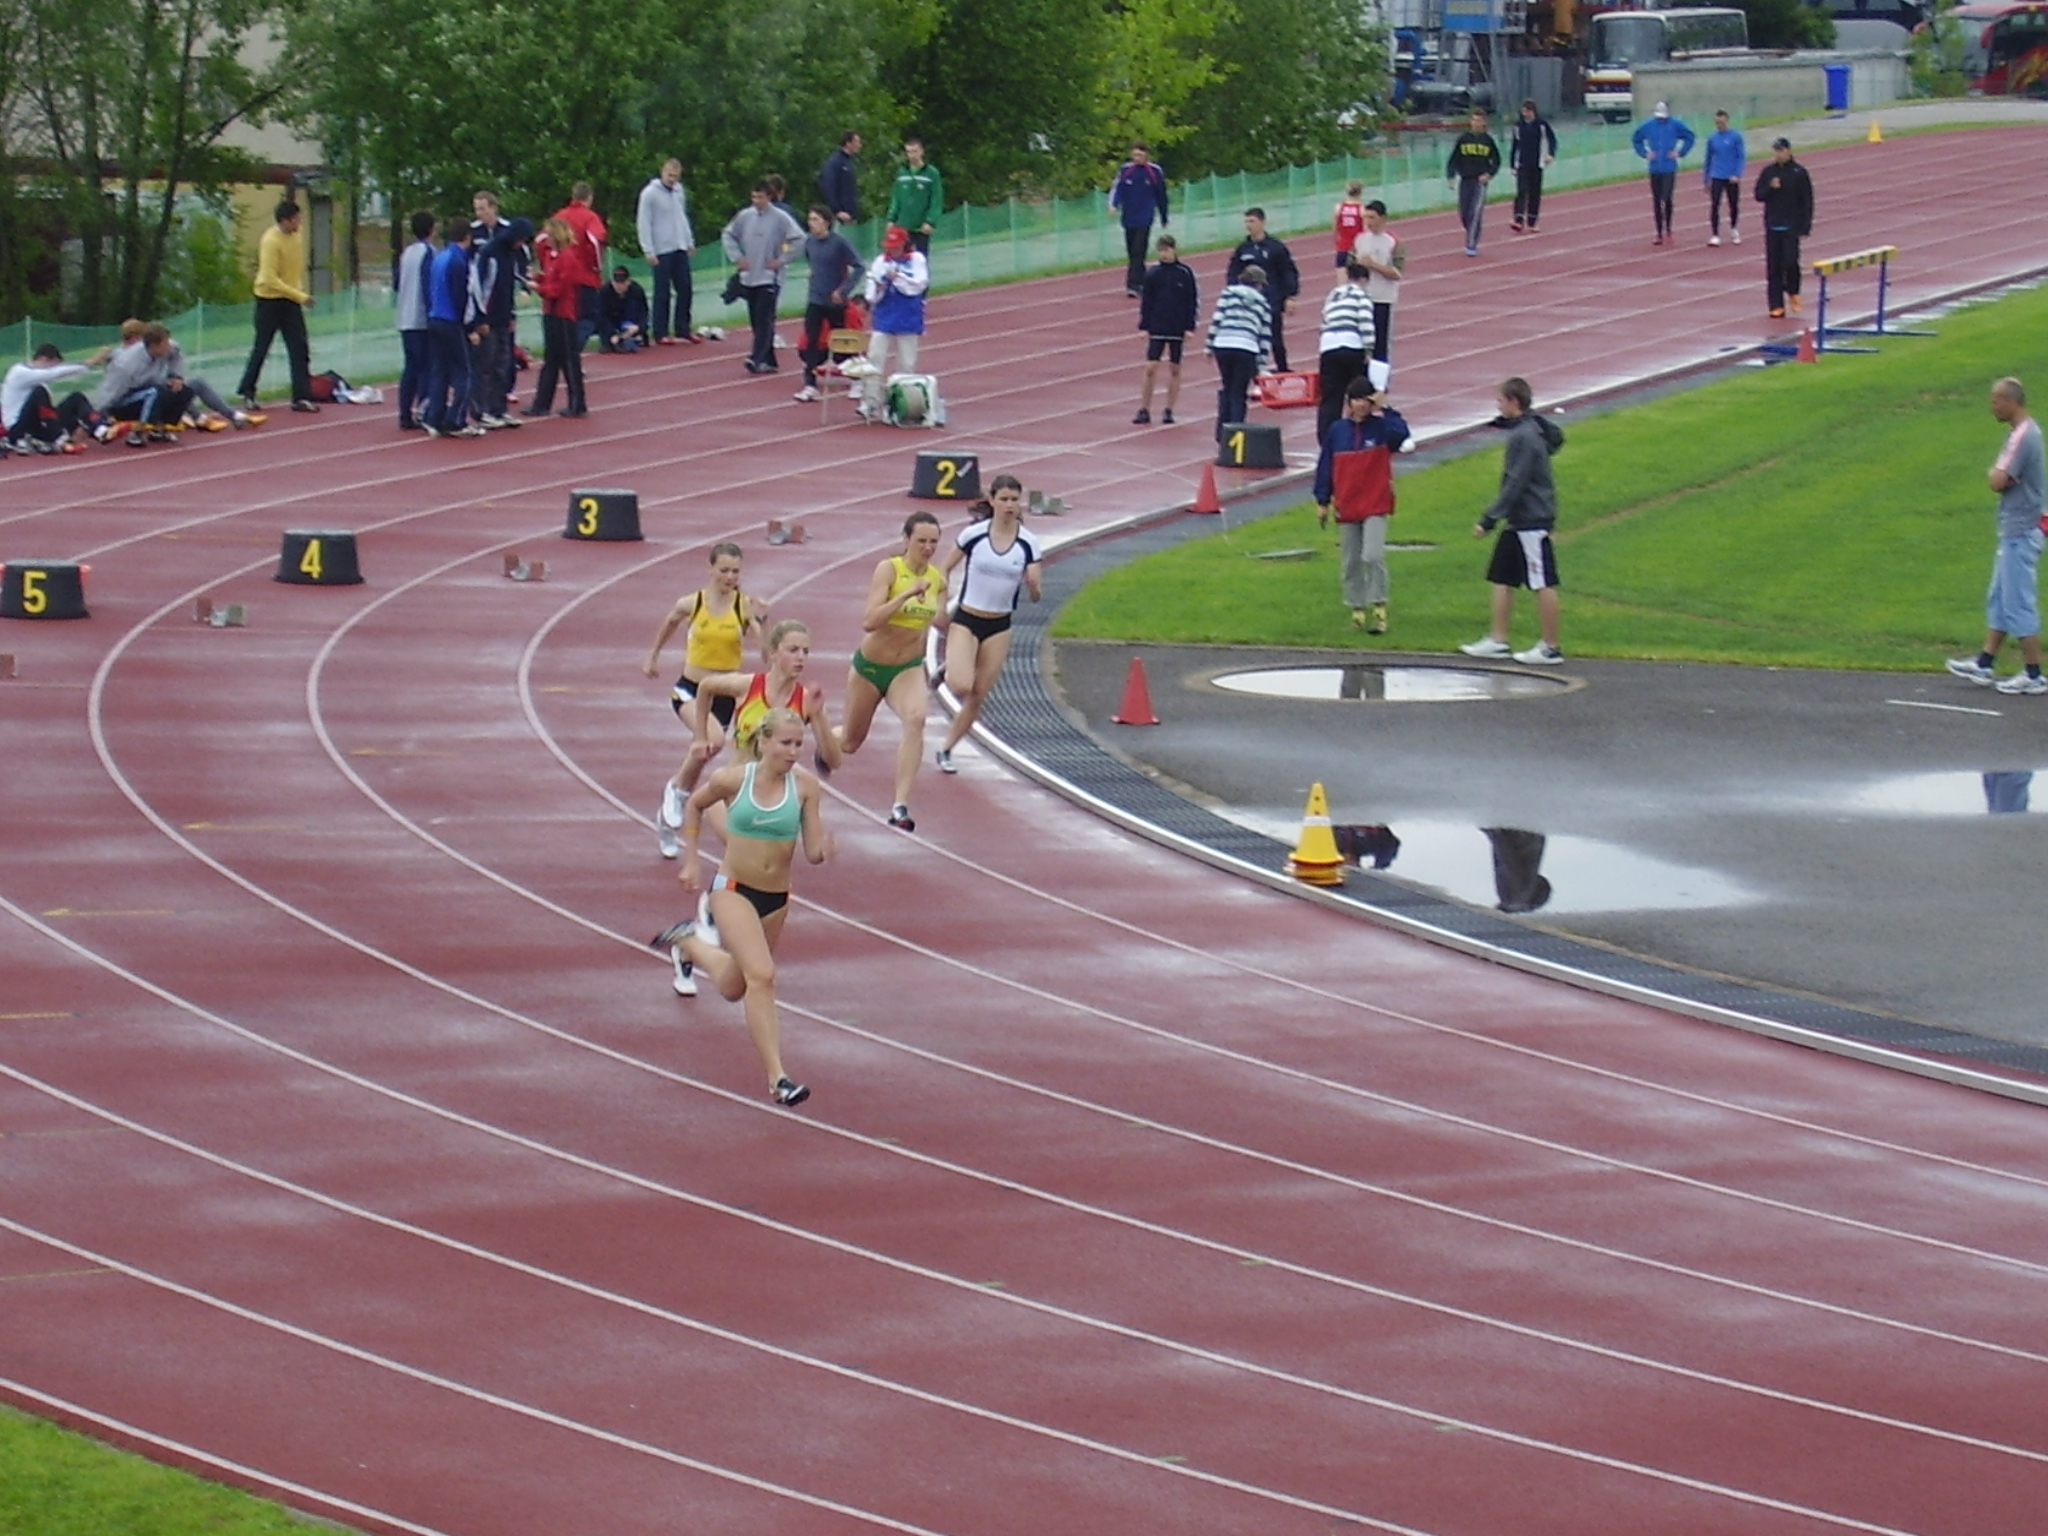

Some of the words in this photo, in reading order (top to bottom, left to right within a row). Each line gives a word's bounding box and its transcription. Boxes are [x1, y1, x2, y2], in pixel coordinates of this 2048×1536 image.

[1228, 430, 1245, 464] 1
[936, 460, 956, 495] 2
[577, 497, 598, 535] 3
[300, 538, 321, 579] 4
[23, 570, 47, 613] 5
